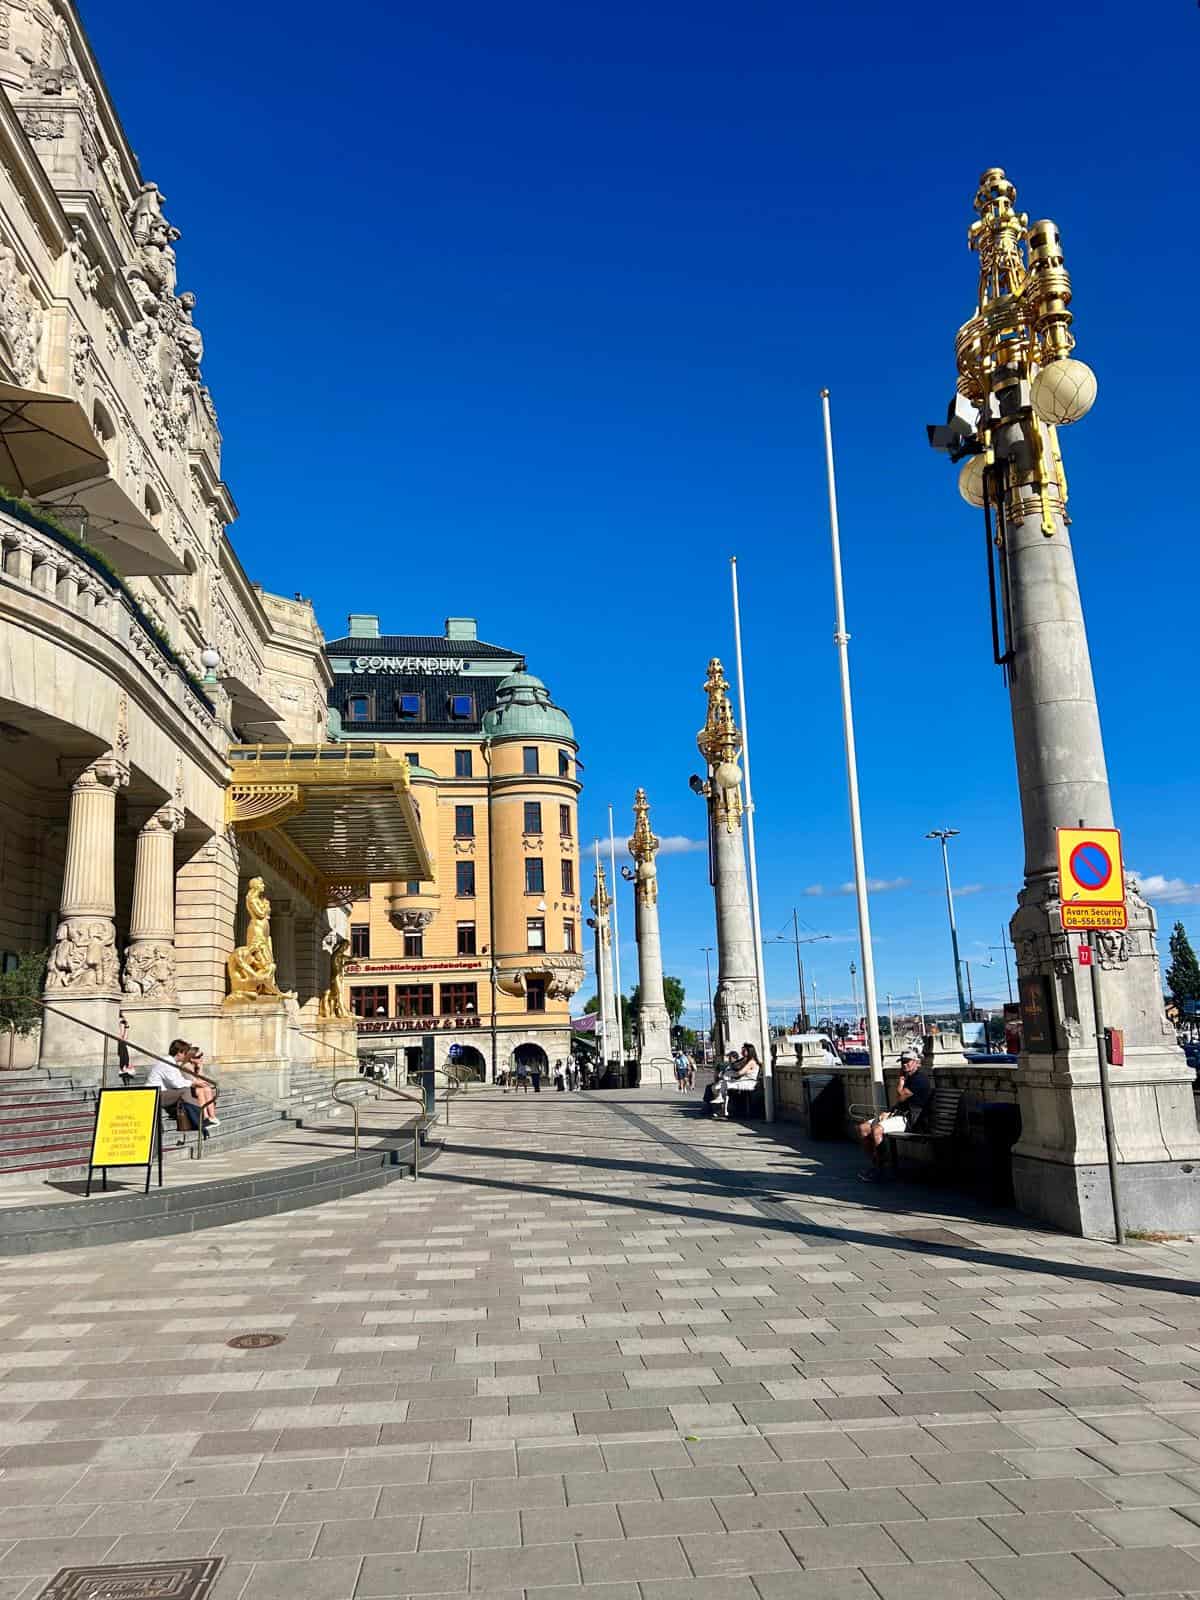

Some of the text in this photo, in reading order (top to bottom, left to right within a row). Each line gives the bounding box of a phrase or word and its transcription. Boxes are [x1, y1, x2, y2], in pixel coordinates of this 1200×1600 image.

[356, 656, 464, 670] CONVENDUM
[1066, 908, 1122, 917] Avarn Security
[1066, 917, 1096, 925] 08-556
[357, 1017, 482, 1032] RESTAURANT & BAR
